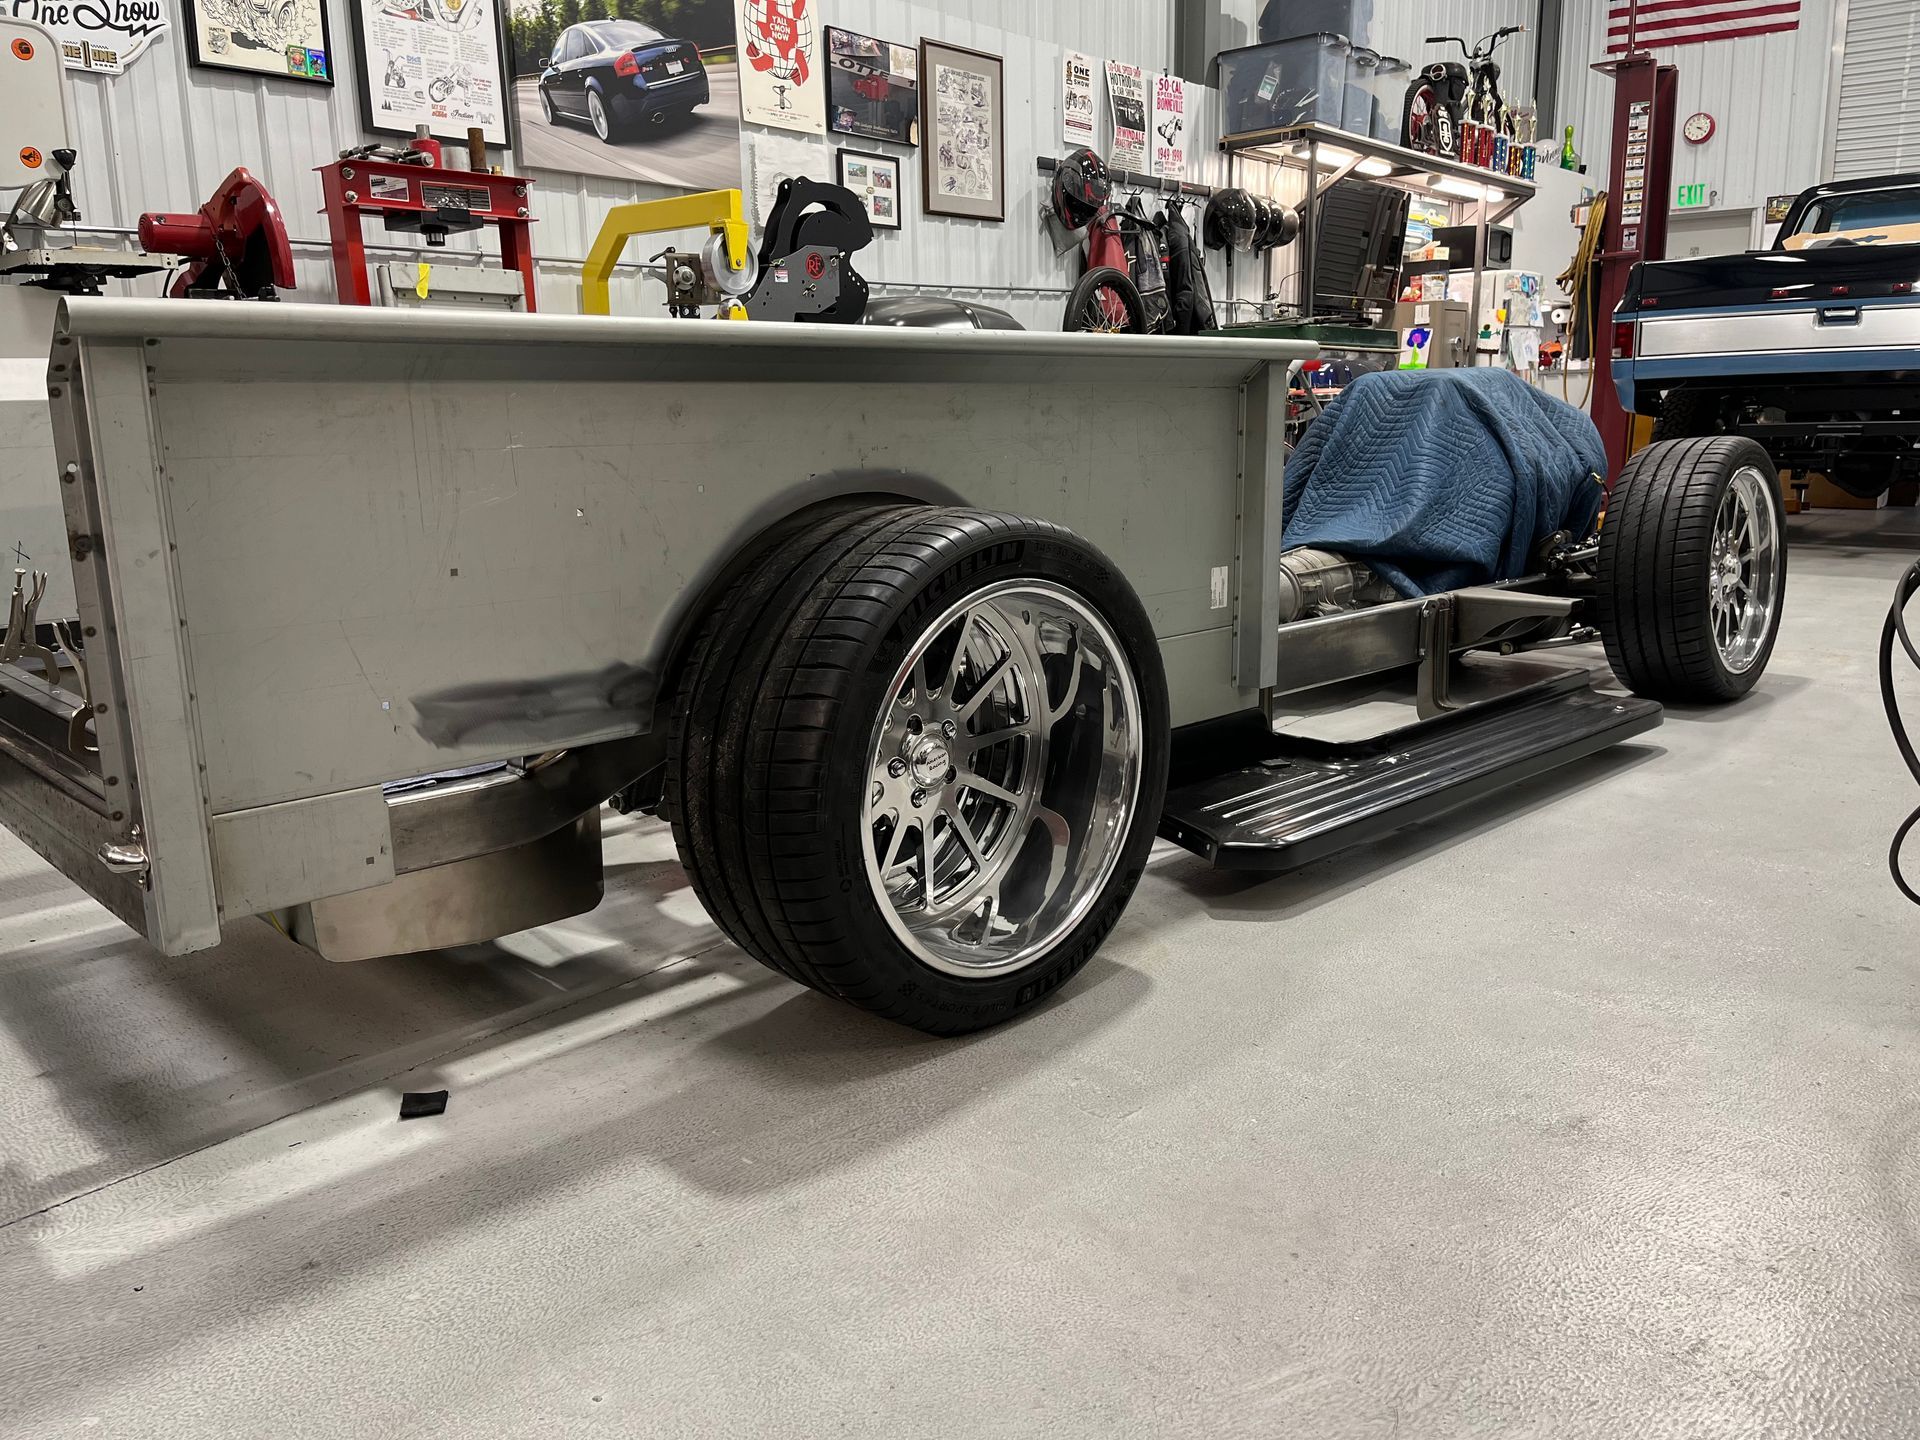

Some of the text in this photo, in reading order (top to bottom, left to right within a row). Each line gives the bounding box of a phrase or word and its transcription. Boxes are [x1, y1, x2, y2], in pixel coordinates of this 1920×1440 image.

[772, 15, 788, 25] Y'ALL
[769, 23, 791, 34] C'MON
[771, 31, 790, 42] NOW
[62, 44, 82, 59] HE
[92, 48, 118, 64] ONE
[1073, 65, 1090, 77] ONE
[1073, 79, 1090, 88] SHOW
[1156, 91, 1172, 99] SPEED
[1156, 96, 1184, 114] BONNEVILLE
[1116, 126, 1145, 141] IRWINDALE
[1677, 183, 1706, 207] EXIT
[898, 541, 1018, 636] MICHELIN
[926, 752, 947, 766] American
[929, 759, 946, 771] Racing
